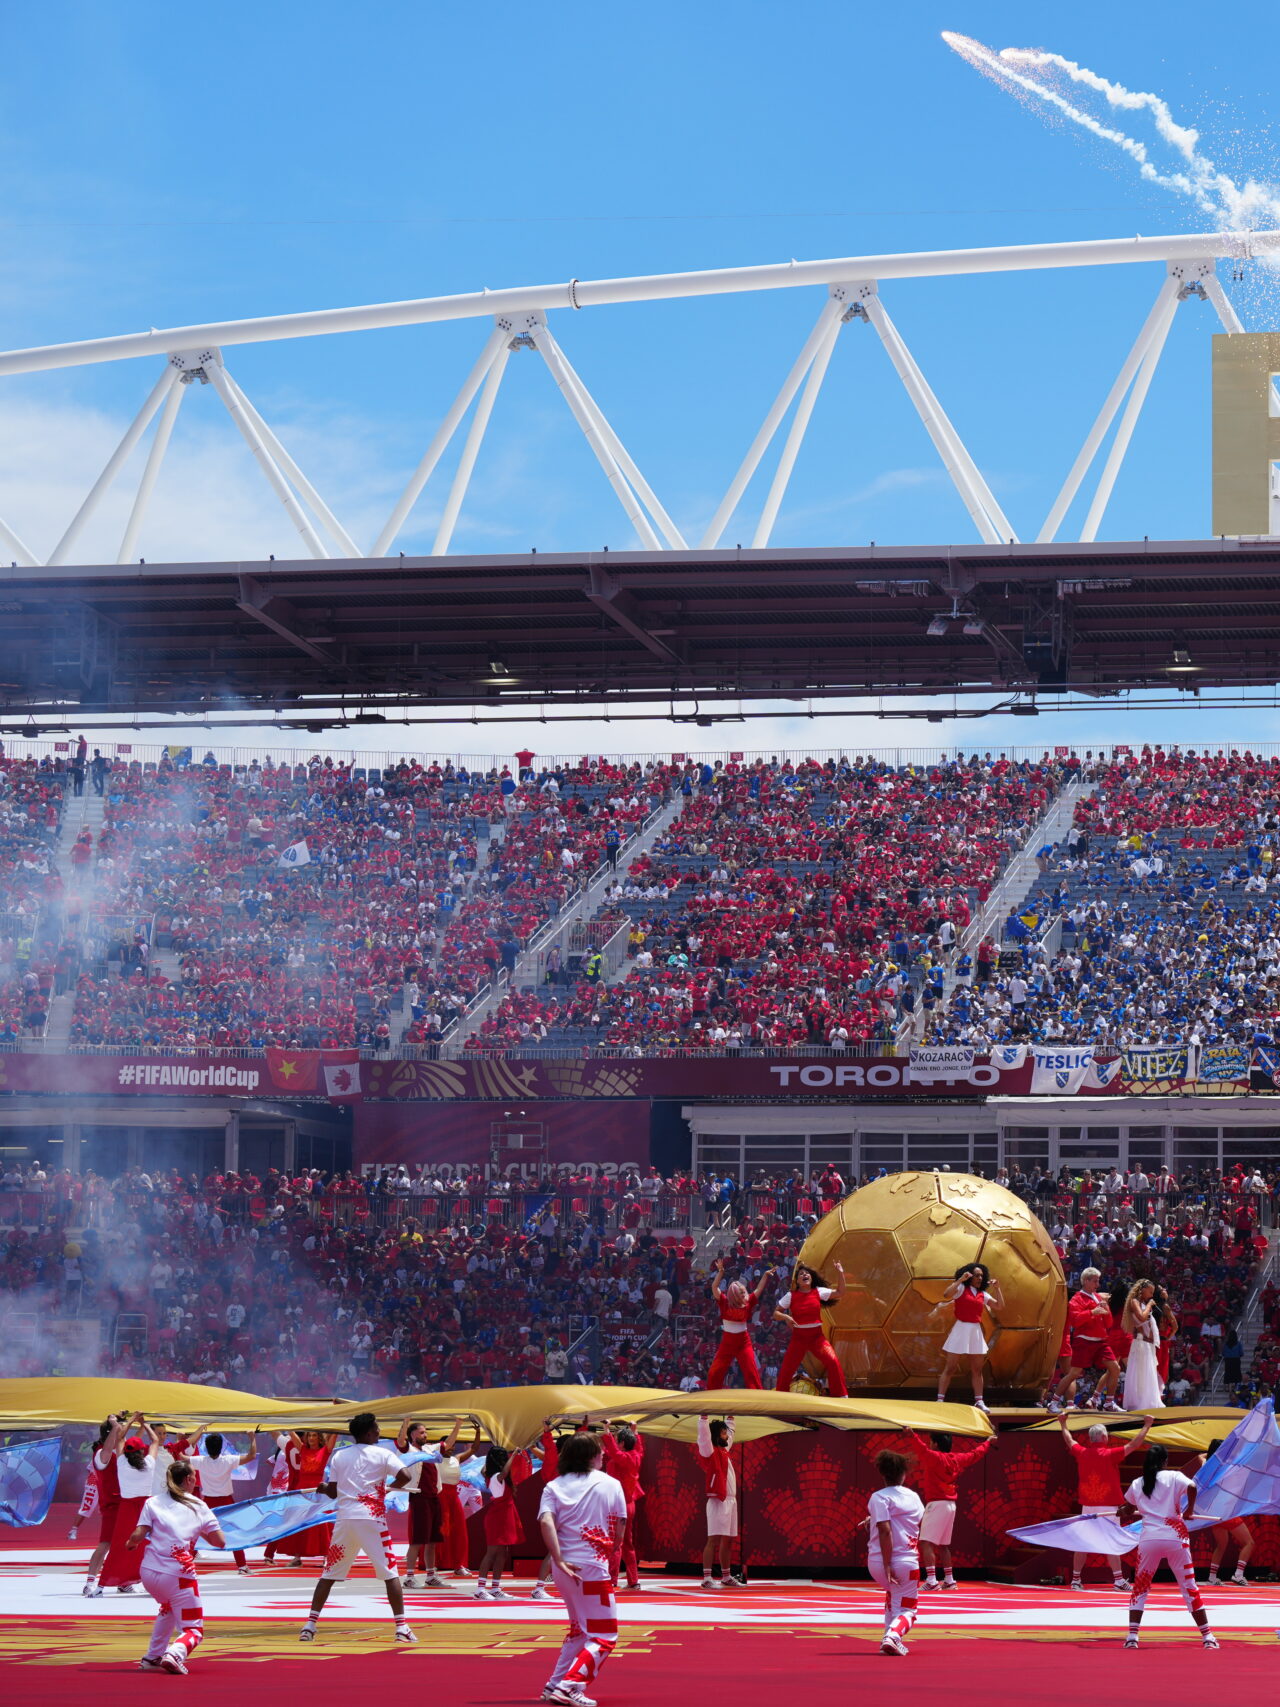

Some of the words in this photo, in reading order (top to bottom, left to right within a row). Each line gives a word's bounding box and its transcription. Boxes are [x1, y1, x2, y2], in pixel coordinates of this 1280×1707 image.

[918, 1052, 963, 1062] KOZARAC
[1036, 1050, 1092, 1069] TESLIĆ
[1122, 1051, 1181, 1078] VITEZ
[119, 1065, 259, 1090] #FIFAWorldCup
[770, 1065, 1000, 1087] TOROO
[674, 1197, 687, 1206] 113
[756, 1196, 769, 1206] 114
[82, 1488, 96, 1512] FIFA
